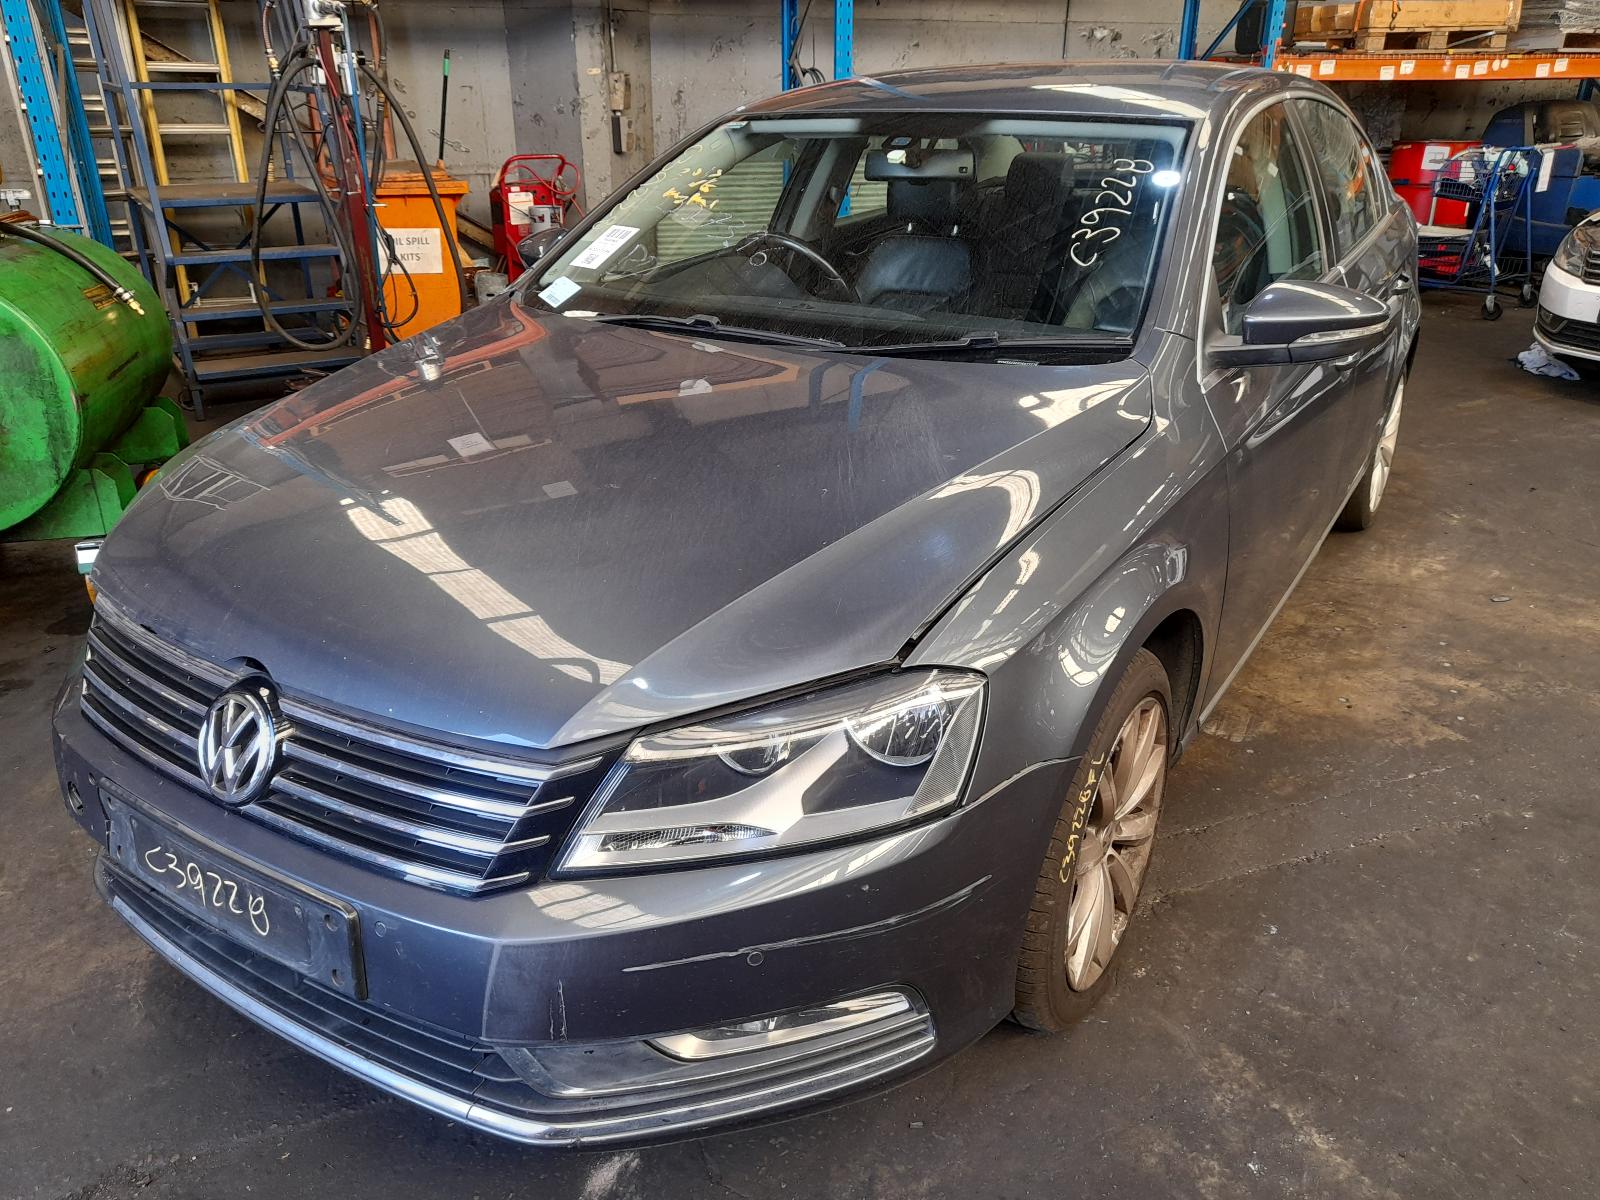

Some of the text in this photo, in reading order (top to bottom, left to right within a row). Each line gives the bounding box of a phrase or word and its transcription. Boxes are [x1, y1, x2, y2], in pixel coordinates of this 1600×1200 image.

[400, 252, 421, 262] KITS
[406, 236, 430, 246] SPILL
[1070, 158, 1155, 267] C39228
[200, 694, 274, 803] VW
[145, 846, 270, 936] C39228
